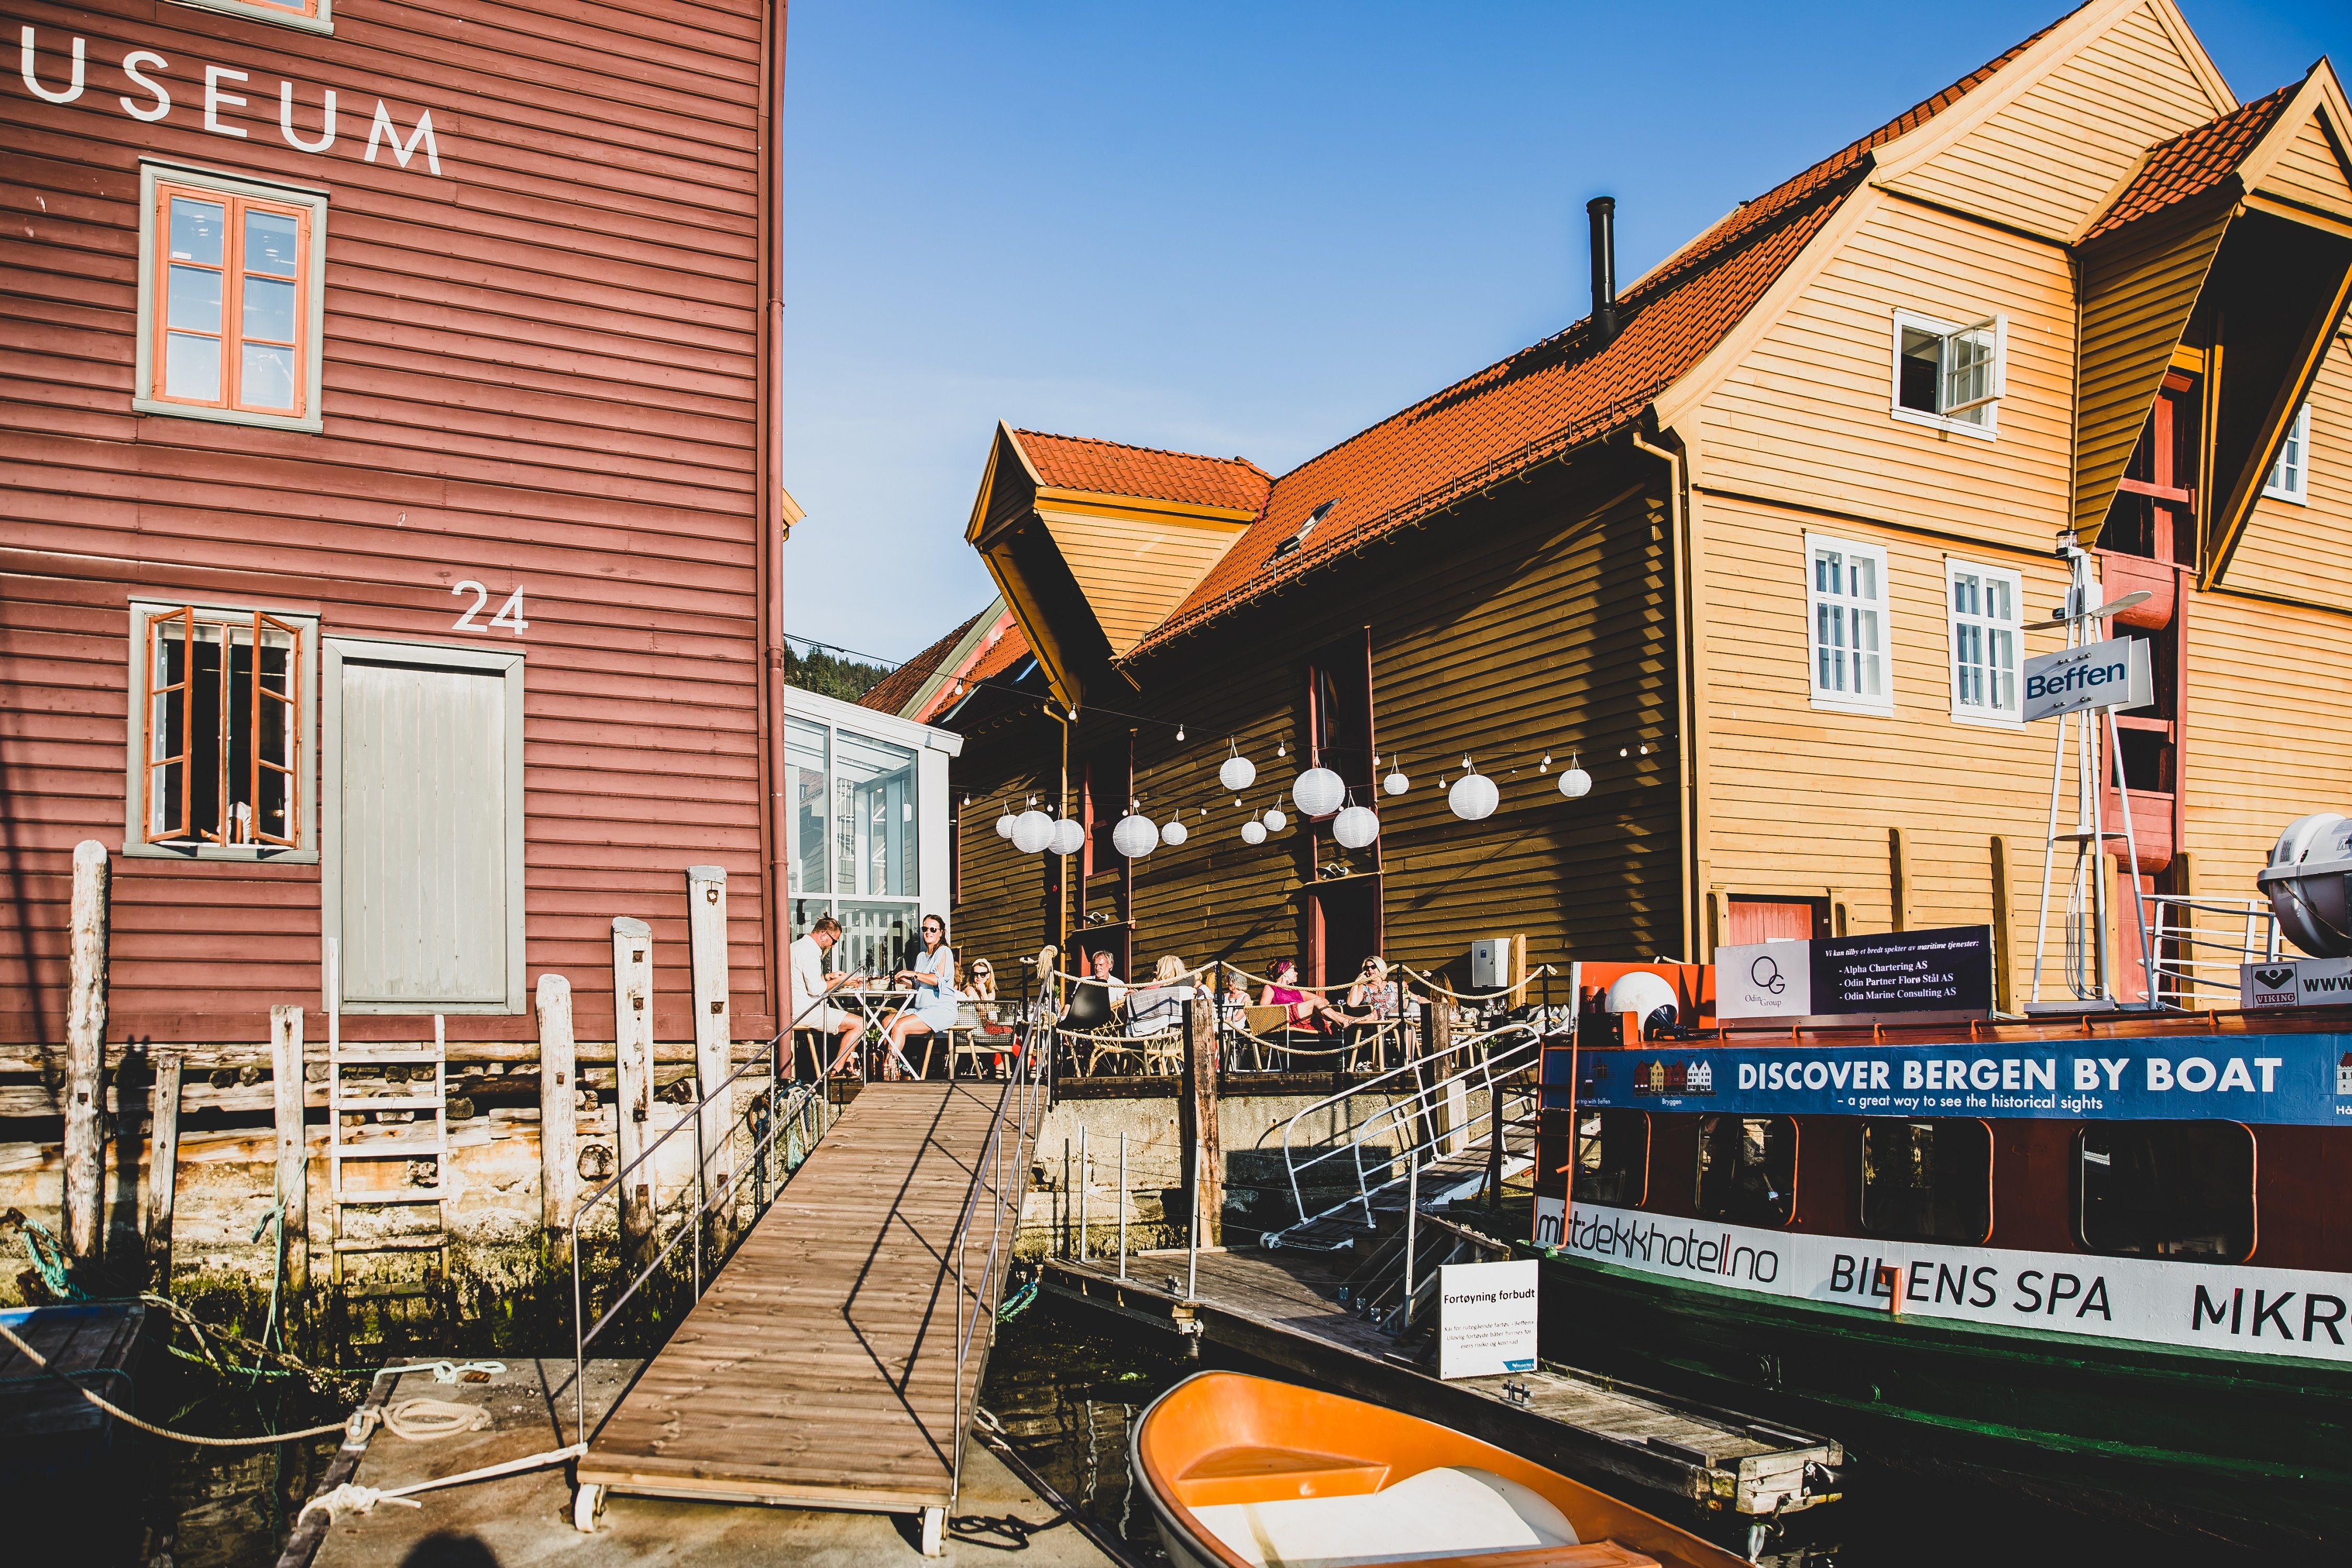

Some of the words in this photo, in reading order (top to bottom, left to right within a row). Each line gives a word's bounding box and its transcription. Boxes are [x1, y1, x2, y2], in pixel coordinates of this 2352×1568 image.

[21, 26, 442, 176] USEUM
[451, 580, 529, 635] 24
[2027, 663, 2125, 700] Beffen
[1846, 948, 1859, 956] tilby
[1884, 945, 1907, 954] spekter
[1917, 942, 1946, 951] maritime
[1947, 940, 1979, 949] tjenester:
[1843, 965, 1867, 975] Alpha
[1869, 962, 1914, 973] Chartering
[1915, 960, 1928, 970] AS
[1844, 978, 1864, 987] Odin
[1865, 976, 1897, 986] Partner
[1898, 975, 1921, 985] Florø
[1922, 973, 1939, 983] Stål
[1941, 973, 1954, 982] AS
[1745, 994, 1762, 1002] Odin
[1760, 998, 1782, 1008] Group
[1844, 992, 1864, 1000] Odin
[1865, 990, 1895, 1000] Marine
[1897, 988, 1942, 999] Consulting
[1943, 986, 1956, 996] AS
[2256, 994, 2295, 1003] VIKING
[1738, 1061, 1890, 1090] DISCOVER
[1903, 1058, 2056, 1090] BERGEN
[2074, 1058, 2129, 1090] BY
[2147, 1057, 2282, 1092] BOAT
[1859, 1096, 1890, 1110] great
[1894, 1097, 1920, 1110] way
[1923, 1096, 1936, 1107] to
[1940, 1098, 1962, 1108] see
[1966, 1093, 1987, 1108] the
[1991, 1093, 2056, 1109] historical
[2060, 1096, 2103, 1113] sights
[1444, 1292, 1496, 1305] Fortøyning
[1499, 1288, 1535, 1300] forbudt
[2012, 1270, 2112, 1321] SPA
[2192, 1284, 2352, 1345] MIKR
